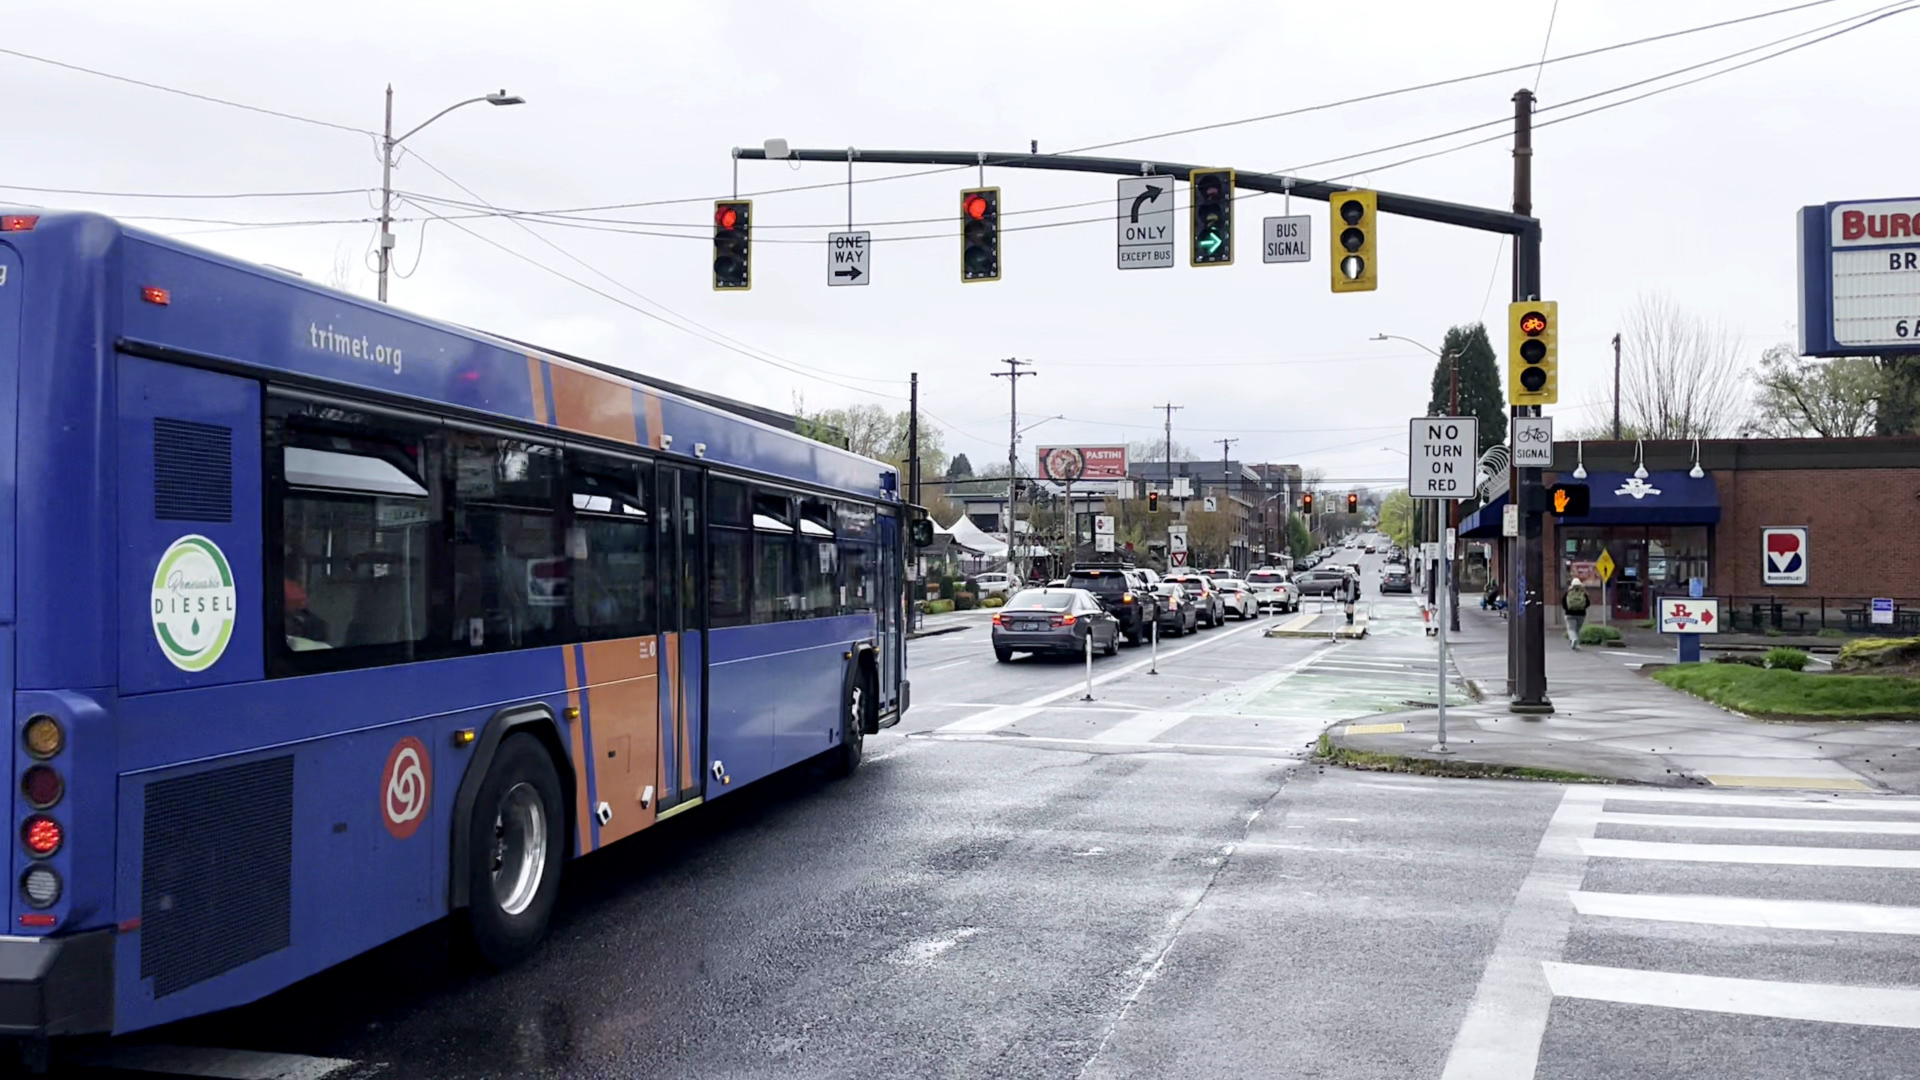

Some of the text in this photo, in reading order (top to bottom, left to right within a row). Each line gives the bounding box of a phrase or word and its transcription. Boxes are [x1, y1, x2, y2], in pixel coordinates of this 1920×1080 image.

[1126, 226, 1166, 240] ONLY
[1276, 223, 1297, 238] BUS
[836, 236, 863, 249] ONE
[1267, 241, 1306, 256] SIGNAL
[835, 250, 864, 263] WAY
[1121, 250, 1171, 261] EXCEPT BUS
[310, 322, 402, 375] trimet.org
[1429, 425, 1459, 440] NO
[1086, 451, 1122, 459] PASTINI
[1424, 445, 1462, 457] TURN
[1516, 449, 1550, 459] SIGNAL
[1432, 462, 1453, 474] ON
[1428, 479, 1457, 491] RED
[155, 596, 233, 614] DIESEL
